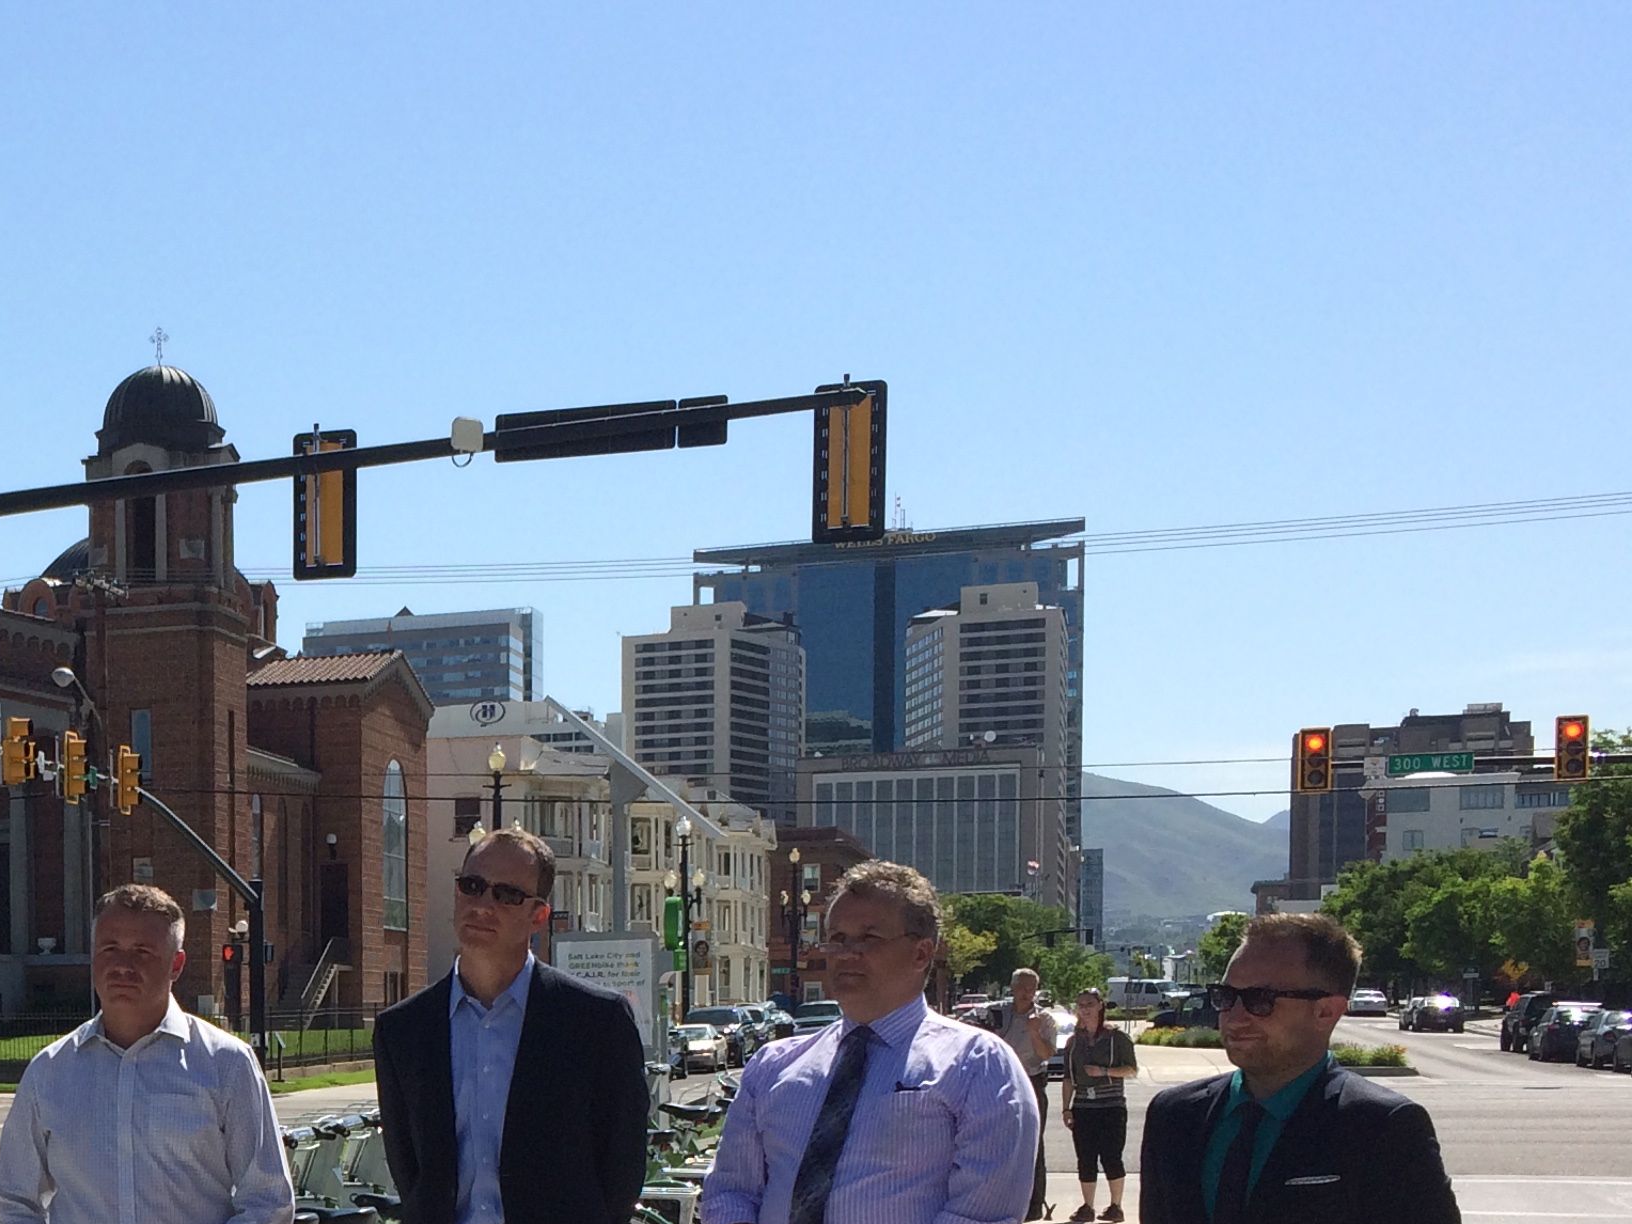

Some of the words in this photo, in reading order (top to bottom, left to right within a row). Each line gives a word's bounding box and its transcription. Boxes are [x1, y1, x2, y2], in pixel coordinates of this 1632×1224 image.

[887, 533, 937, 546] FARGO
[841, 753, 922, 770] BROADWAY
[943, 750, 991, 766] MEDIA
[1394, 757, 1421, 770] 300
[1431, 754, 1468, 768] WEST
[606, 951, 624, 961] City
